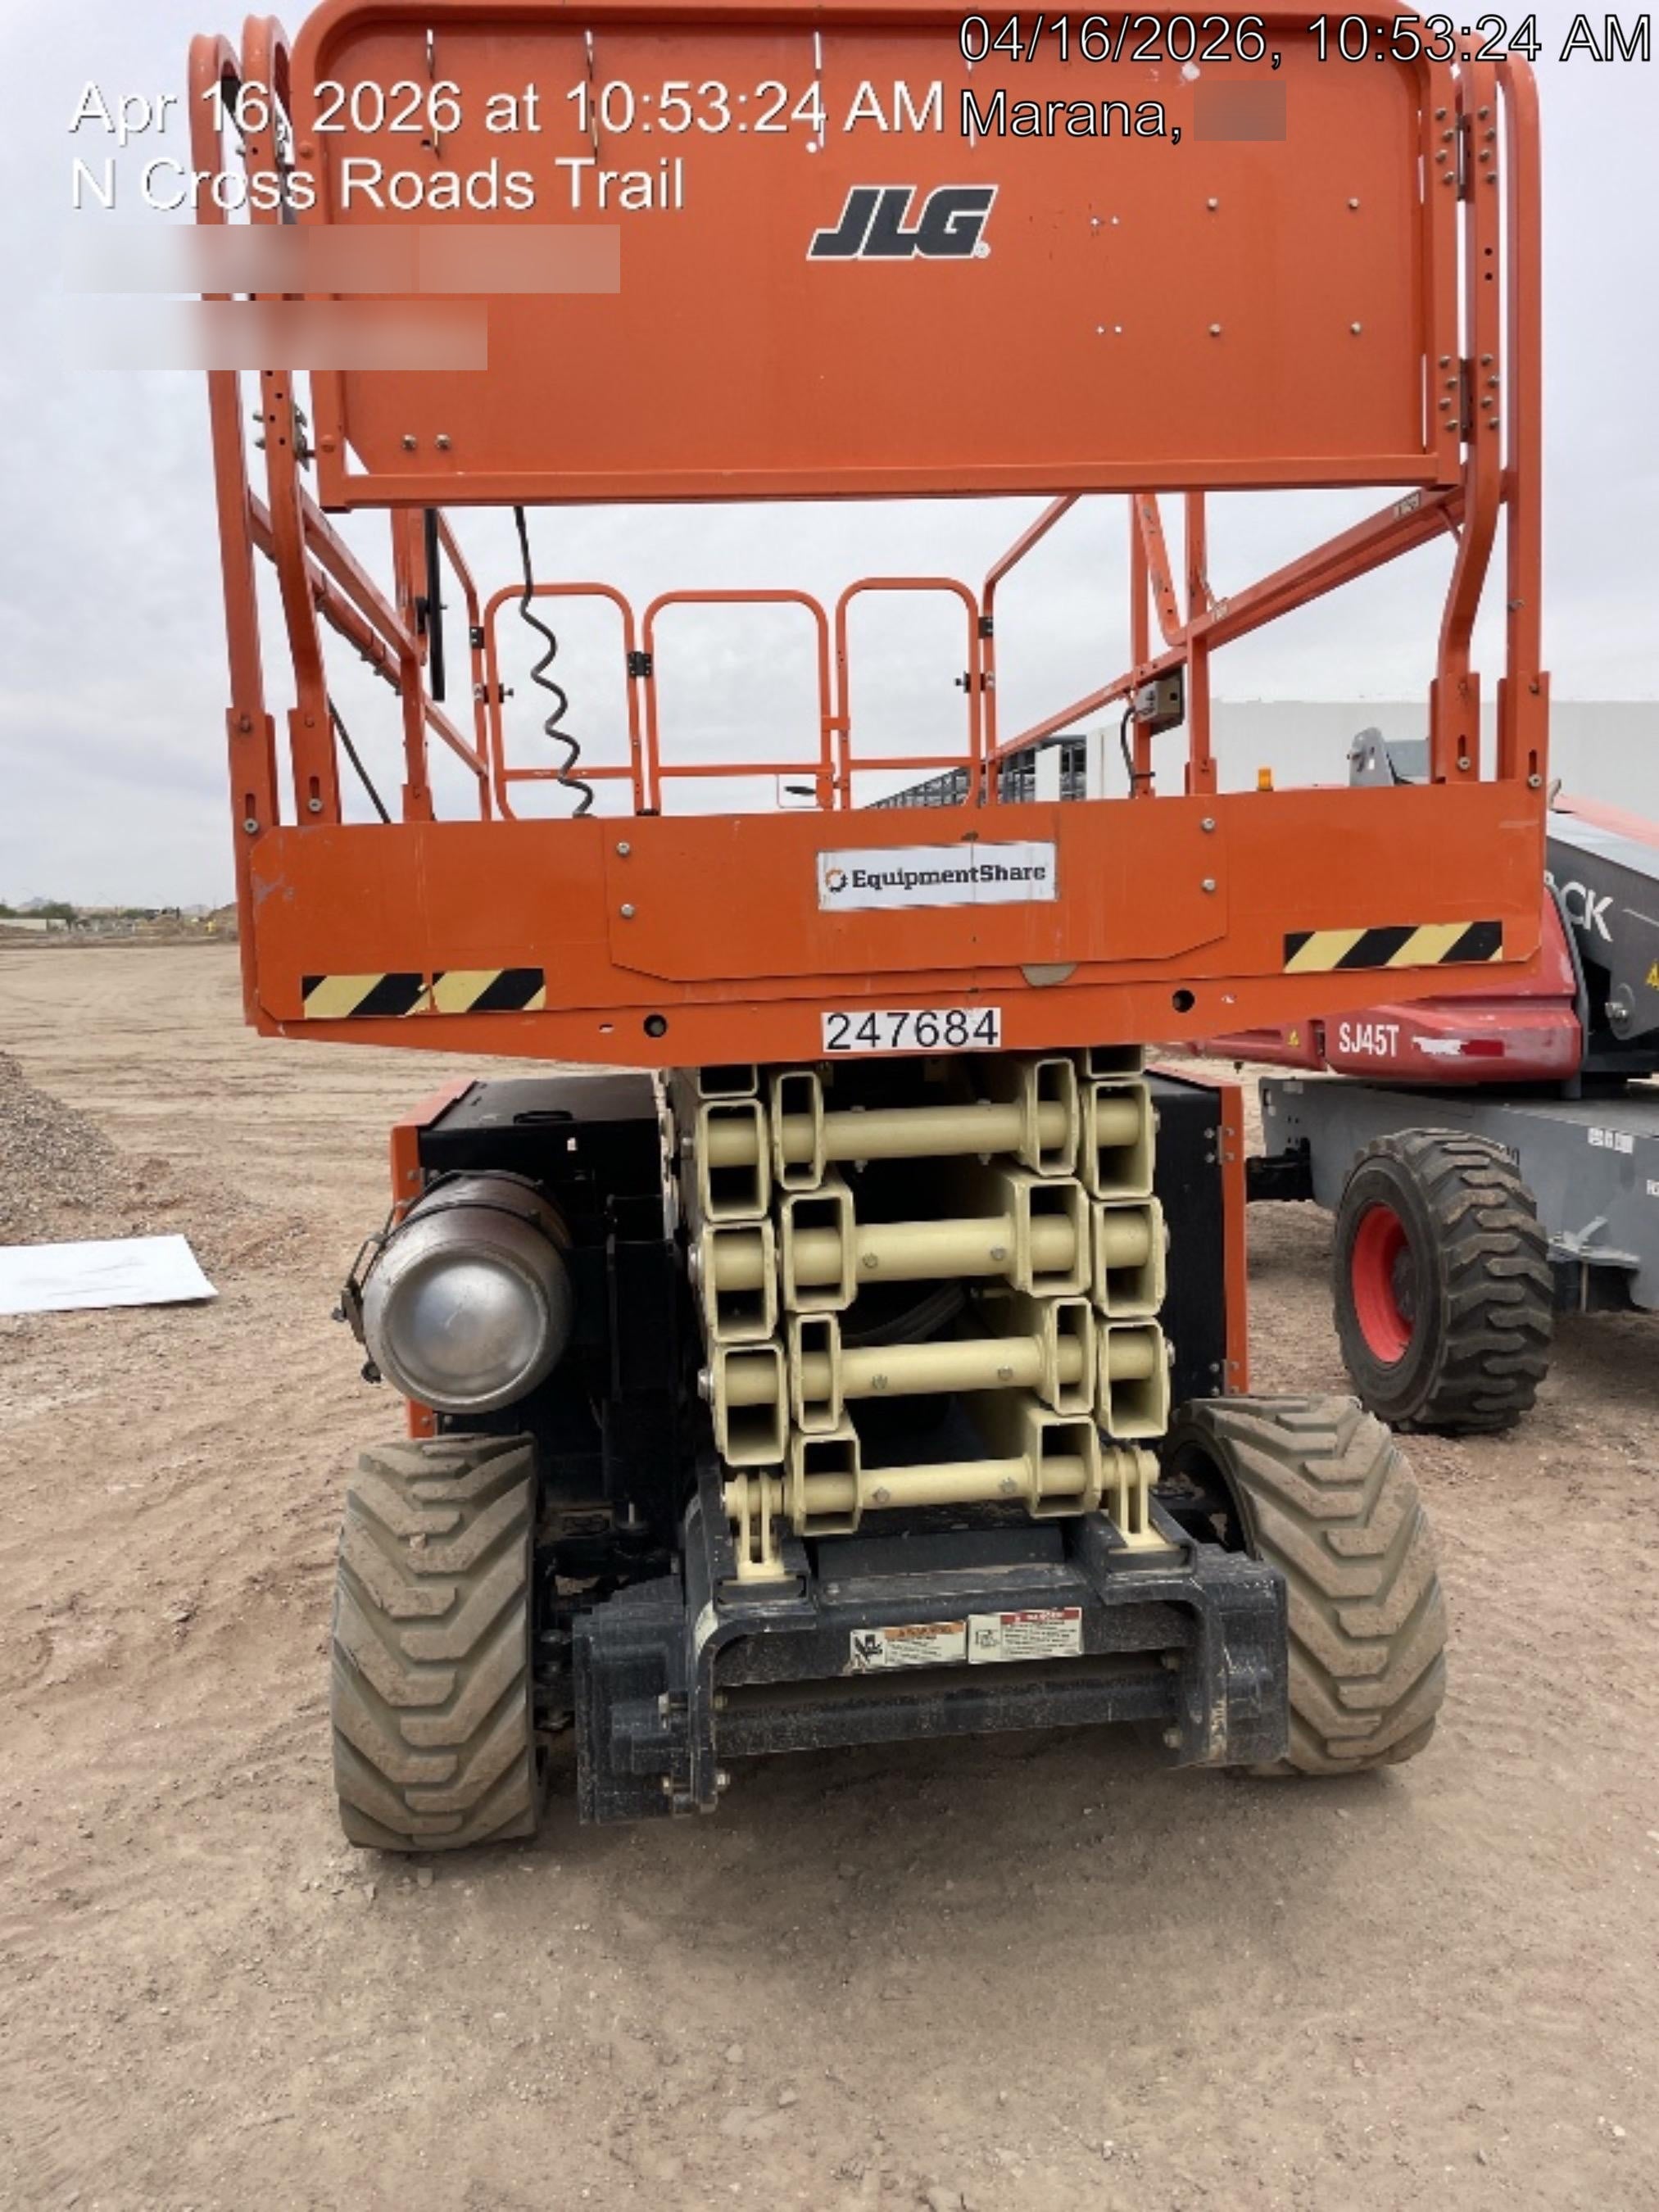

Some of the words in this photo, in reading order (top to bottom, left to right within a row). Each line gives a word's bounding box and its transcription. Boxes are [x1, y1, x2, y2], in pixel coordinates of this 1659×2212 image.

[806, 184, 998, 261] JLG
[852, 864, 1046, 891] EquipmentShare
[1543, 869, 1613, 941] CK
[826, 1009, 998, 1051] 247684
[1339, 1022, 1399, 1057] SJ45T
